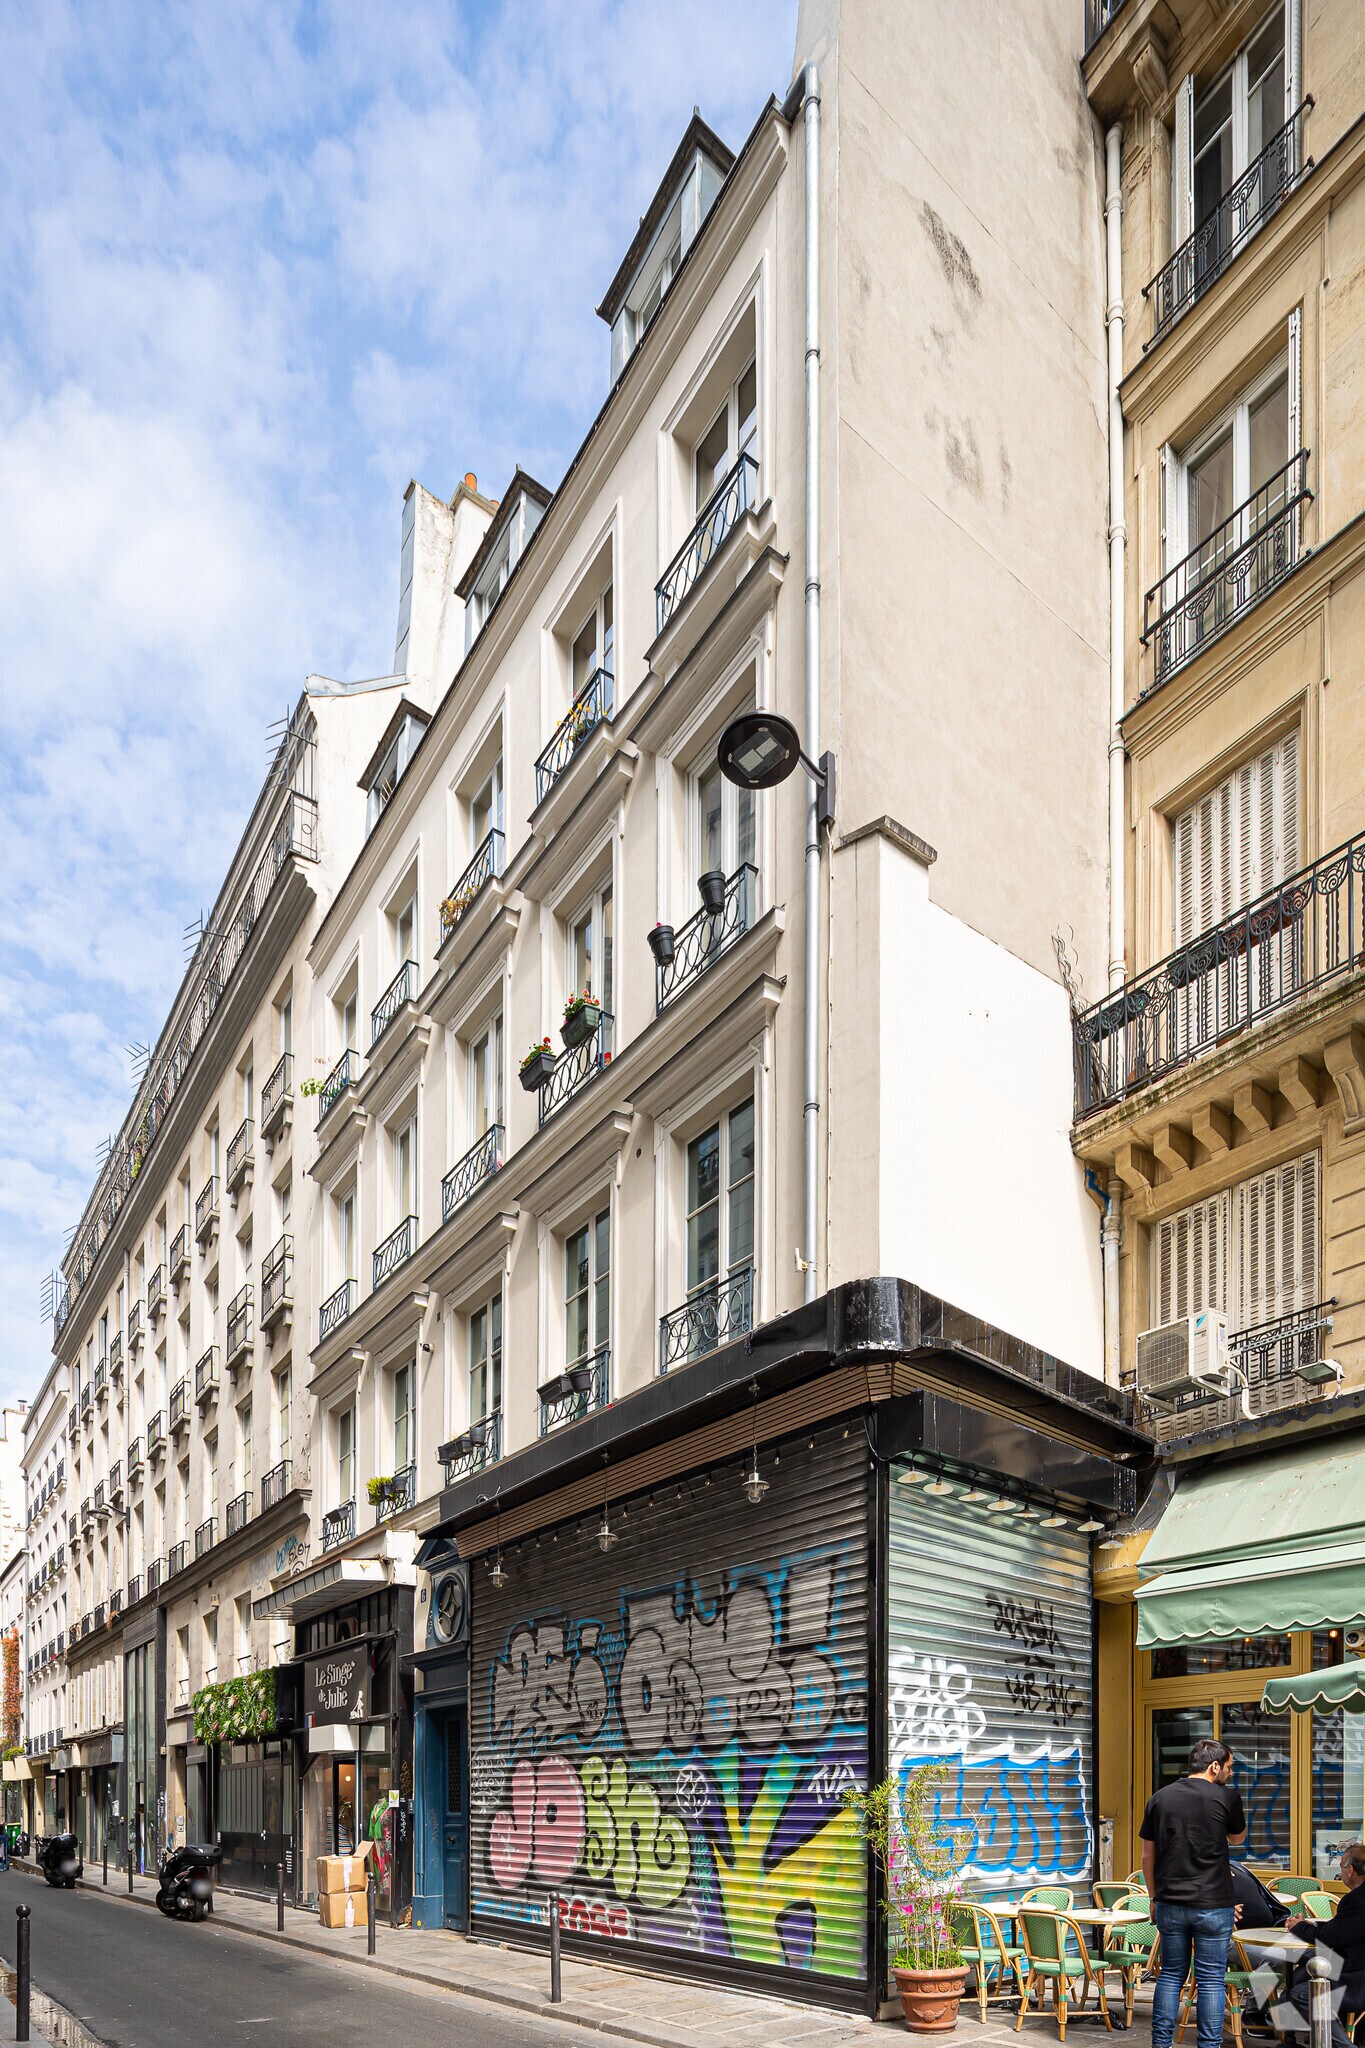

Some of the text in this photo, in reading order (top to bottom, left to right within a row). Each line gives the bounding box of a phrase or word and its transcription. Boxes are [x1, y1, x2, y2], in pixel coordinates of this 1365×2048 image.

[315, 1662, 353, 1687] Le Singe
[318, 1687, 348, 1710] de Julie
